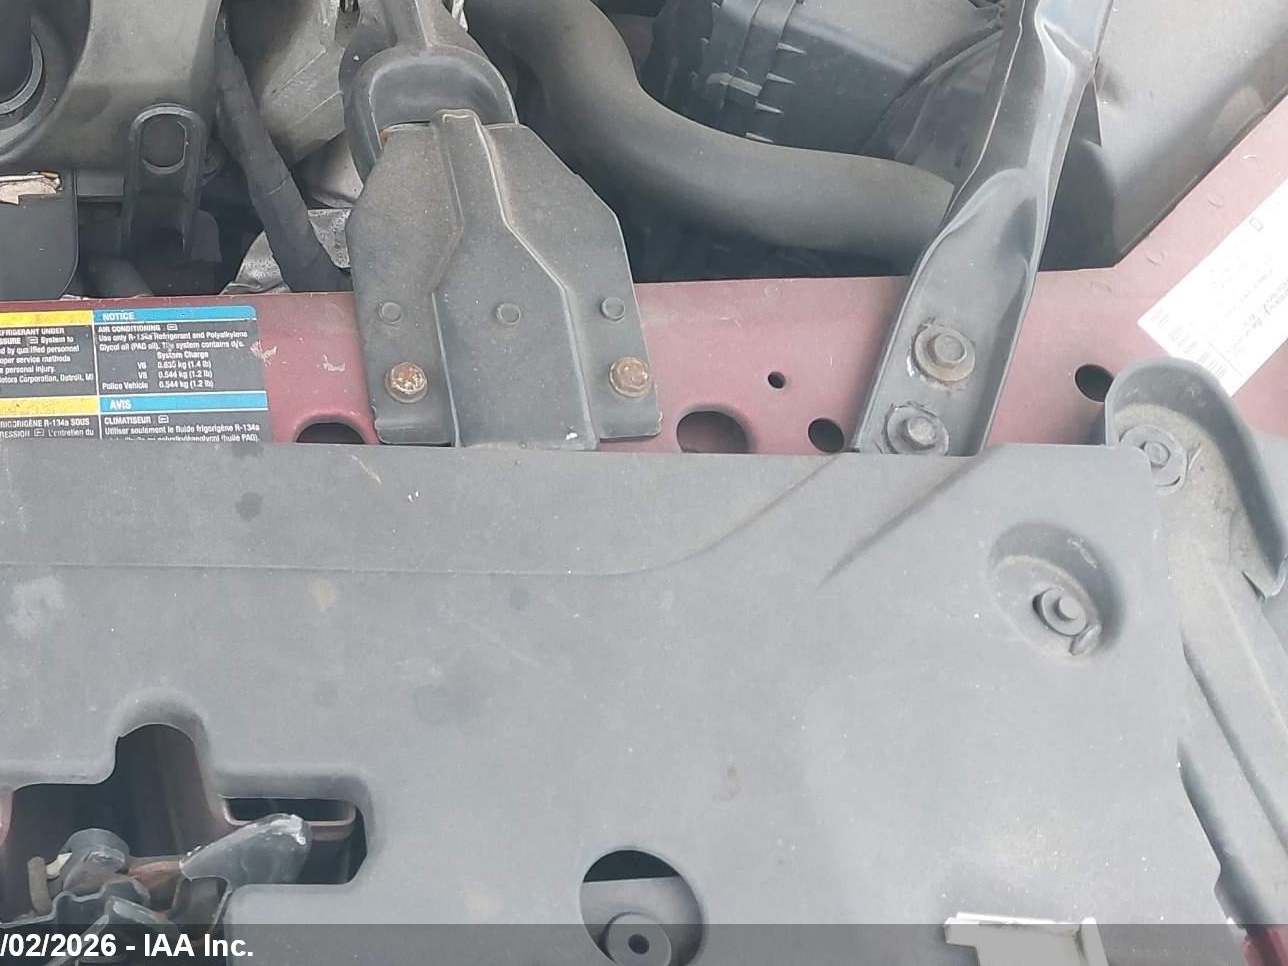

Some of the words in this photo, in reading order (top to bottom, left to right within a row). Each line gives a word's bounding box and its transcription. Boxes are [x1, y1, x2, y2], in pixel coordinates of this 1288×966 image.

[102, 312, 135, 321] NOTICE
[41, 327, 65, 335] UNDER
[98, 325, 110, 333] AIR
[111, 324, 161, 332] CONDITIONING
[40, 336, 66, 345] System
[98, 334, 111, 342] Use
[113, 334, 127, 343] only
[154, 332, 191, 342] Refrigerant
[192, 331, 205, 339] and
[206, 330, 248, 340] Polyalkylene
[6, 347, 15, 356] by
[46, 345, 80, 354] personnel
[99, 343, 119, 352] Glycol
[120, 343, 130, 351] oil
[130, 342, 147, 351] (PAG
[175, 341, 200, 351] system
[201, 340, 230, 349] contains
[16, 356, 41, 364] service
[41, 355, 71, 363] methods
[156, 351, 183, 360] System
[184, 351, 209, 360] Charge
[5, 366, 34, 375] personal
[35, 365, 55, 374] injury.
[136, 362, 147, 370] V6
[177, 361, 187, 370] kg
[188, 360, 201, 369] (1.4
[202, 360, 212, 369] lb)
[18, 375, 59, 384] Corporation,
[60, 374, 84, 382] Detroit,
[85, 373, 94, 381] MI
[158, 371, 177, 379] 0.544
[178, 371, 188, 380] kg
[189, 370, 202, 379] (1.2
[203, 370, 213, 379] lb)
[102, 382, 123, 391] Police
[124, 381, 148, 390] Vehicle
[159, 380, 178, 389] 0.544
[179, 380, 189, 390] kg
[189, 380, 203, 389] (1.2
[204, 379, 214, 389] lb)
[109, 399, 132, 410] AVIS
[43, 419, 70, 428] R-134a
[70, 418, 90, 426] SOUS
[104, 416, 151, 425] CLIMATISEUR
[85, 428, 94, 436] du
[104, 426, 130, 435] Utiliser
[130, 425, 167, 434] seulement
[167, 425, 175, 433] le
[175, 424, 195, 433] fluide
[234, 423, 260, 432] R-134a
